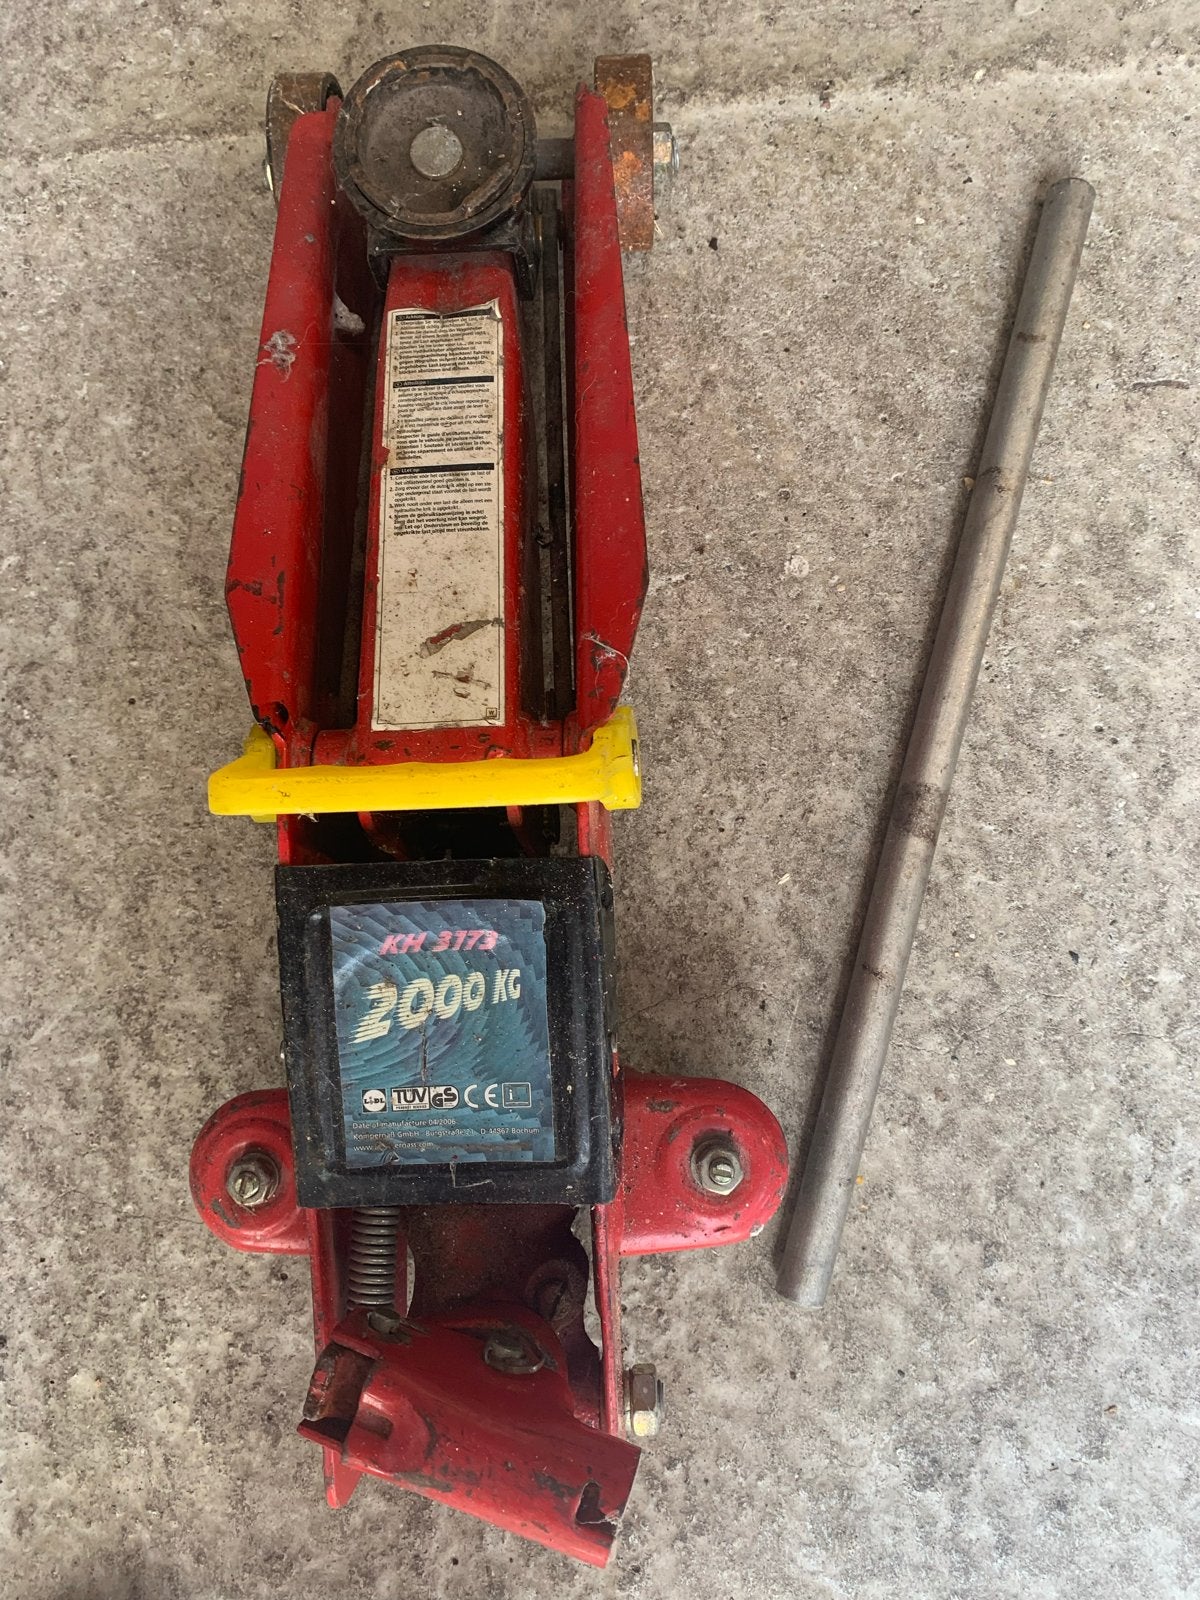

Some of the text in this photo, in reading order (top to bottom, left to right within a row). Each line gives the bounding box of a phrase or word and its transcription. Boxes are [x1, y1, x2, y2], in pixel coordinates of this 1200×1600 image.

[380, 930, 498, 955] KH 3173
[348, 969, 521, 1045] 2000 KG
[393, 1087, 427, 1103] TÜV
[432, 1087, 457, 1107] GS
[464, 1083, 499, 1108] CE
[381, 1120, 427, 1128] manufacture
